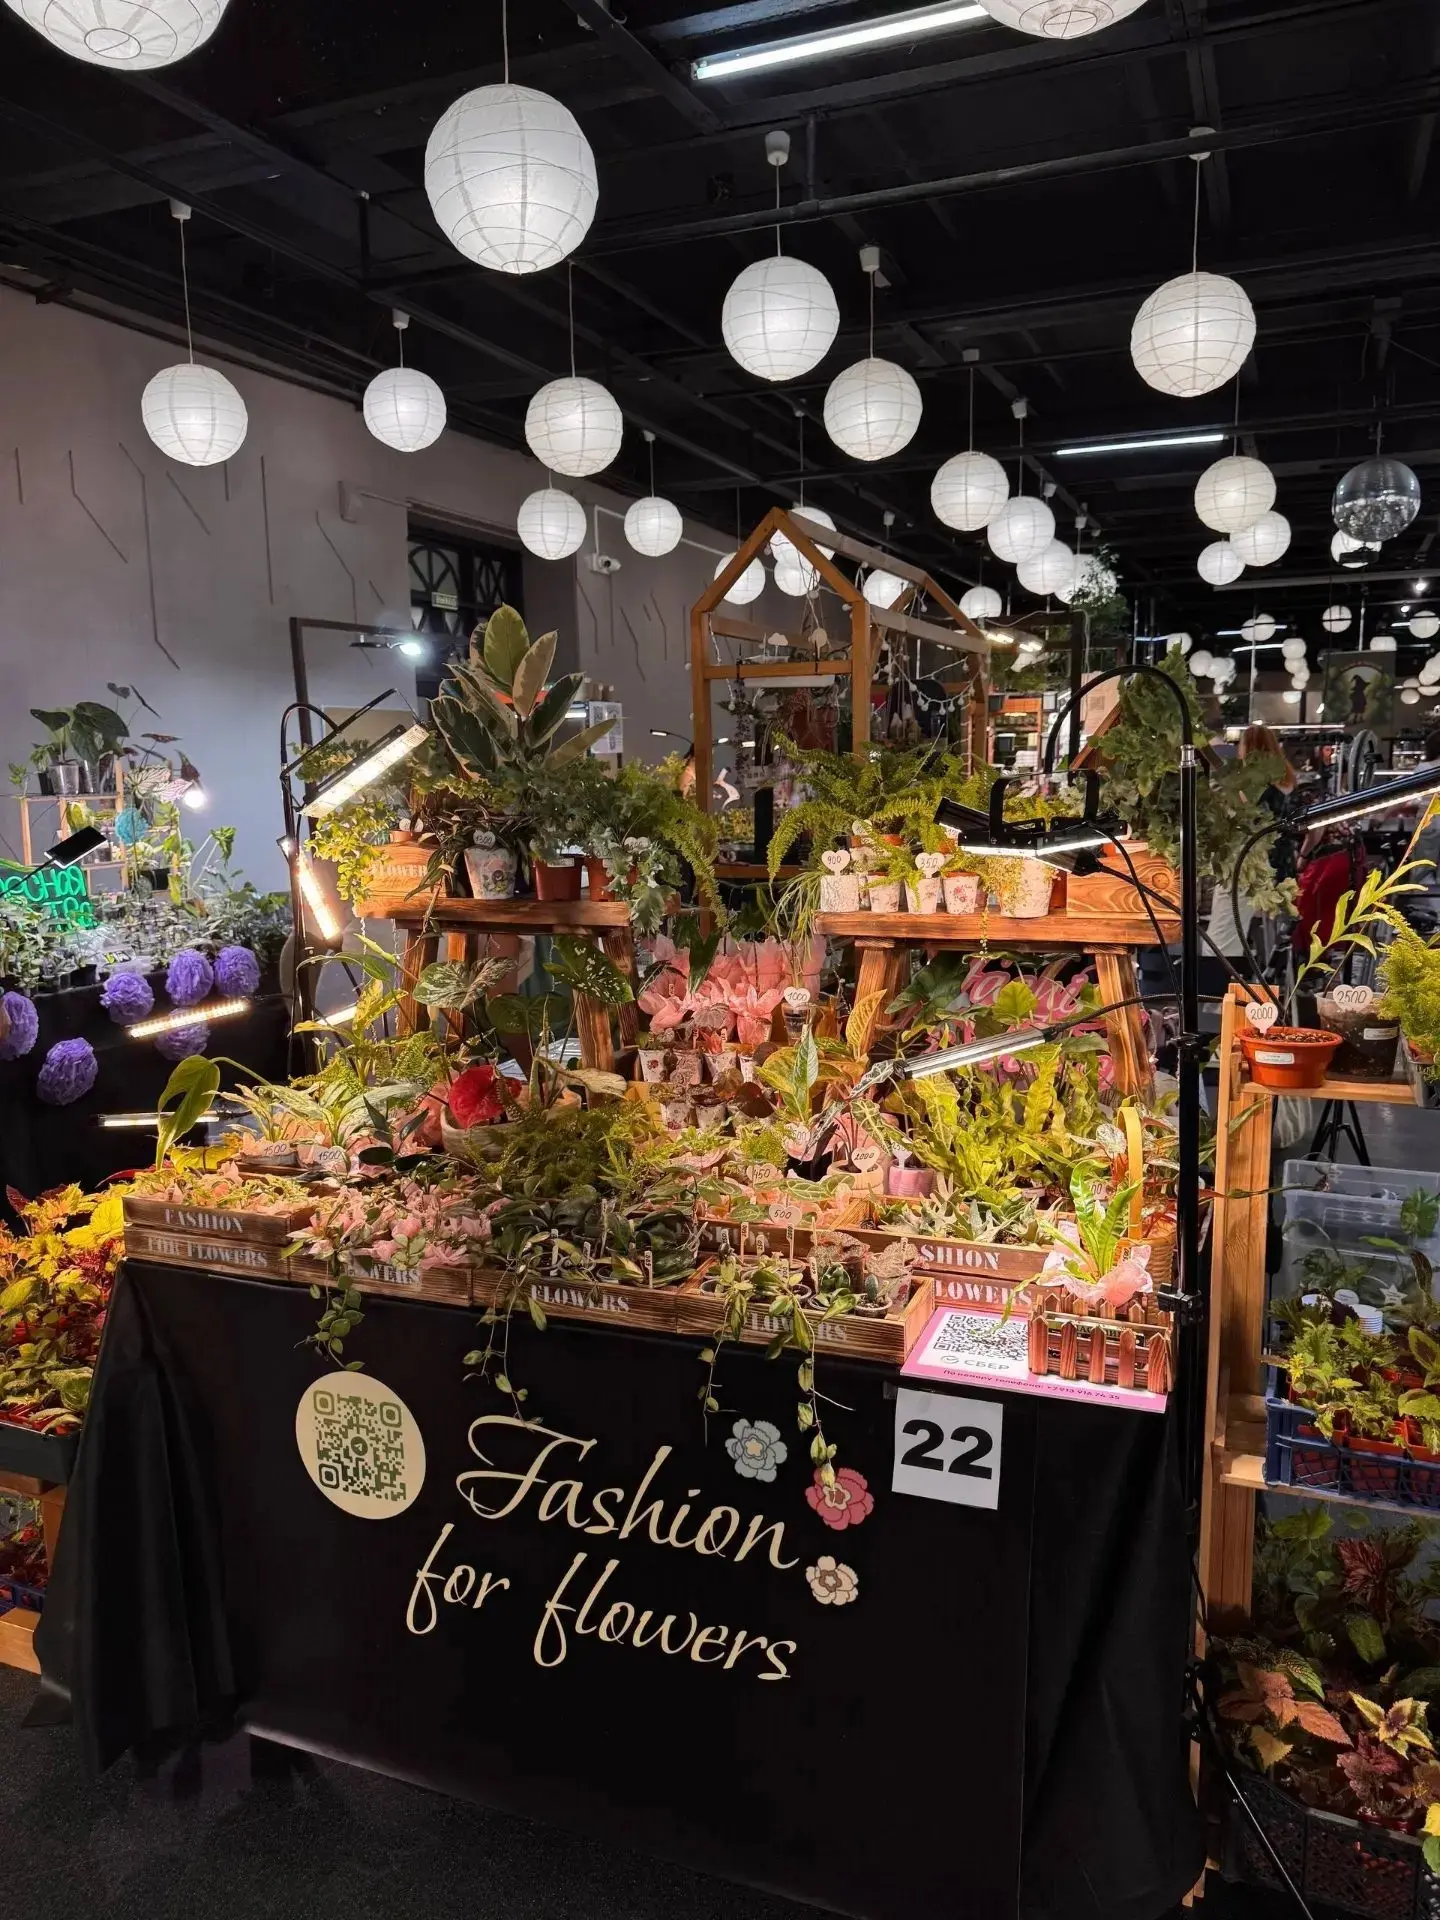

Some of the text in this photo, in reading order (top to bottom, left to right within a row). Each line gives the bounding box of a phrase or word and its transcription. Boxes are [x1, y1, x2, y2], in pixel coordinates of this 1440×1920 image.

[827, 855, 842, 865] 900
[787, 991, 808, 1002] 1000
[1336, 989, 1368, 1005] 2500
[1250, 1006, 1273, 1021] 2000
[264, 1143, 287, 1155] 1500
[164, 1208, 243, 1234] FASHION
[773, 1209, 792, 1219] 500
[187, 1240, 269, 1268] FLOWERS
[963, 1359, 1010, 1370] СБЕР
[901, 1419, 993, 1480] 22
[456, 1415, 800, 1570] Fashion
[406, 1523, 797, 1681] for flowers
